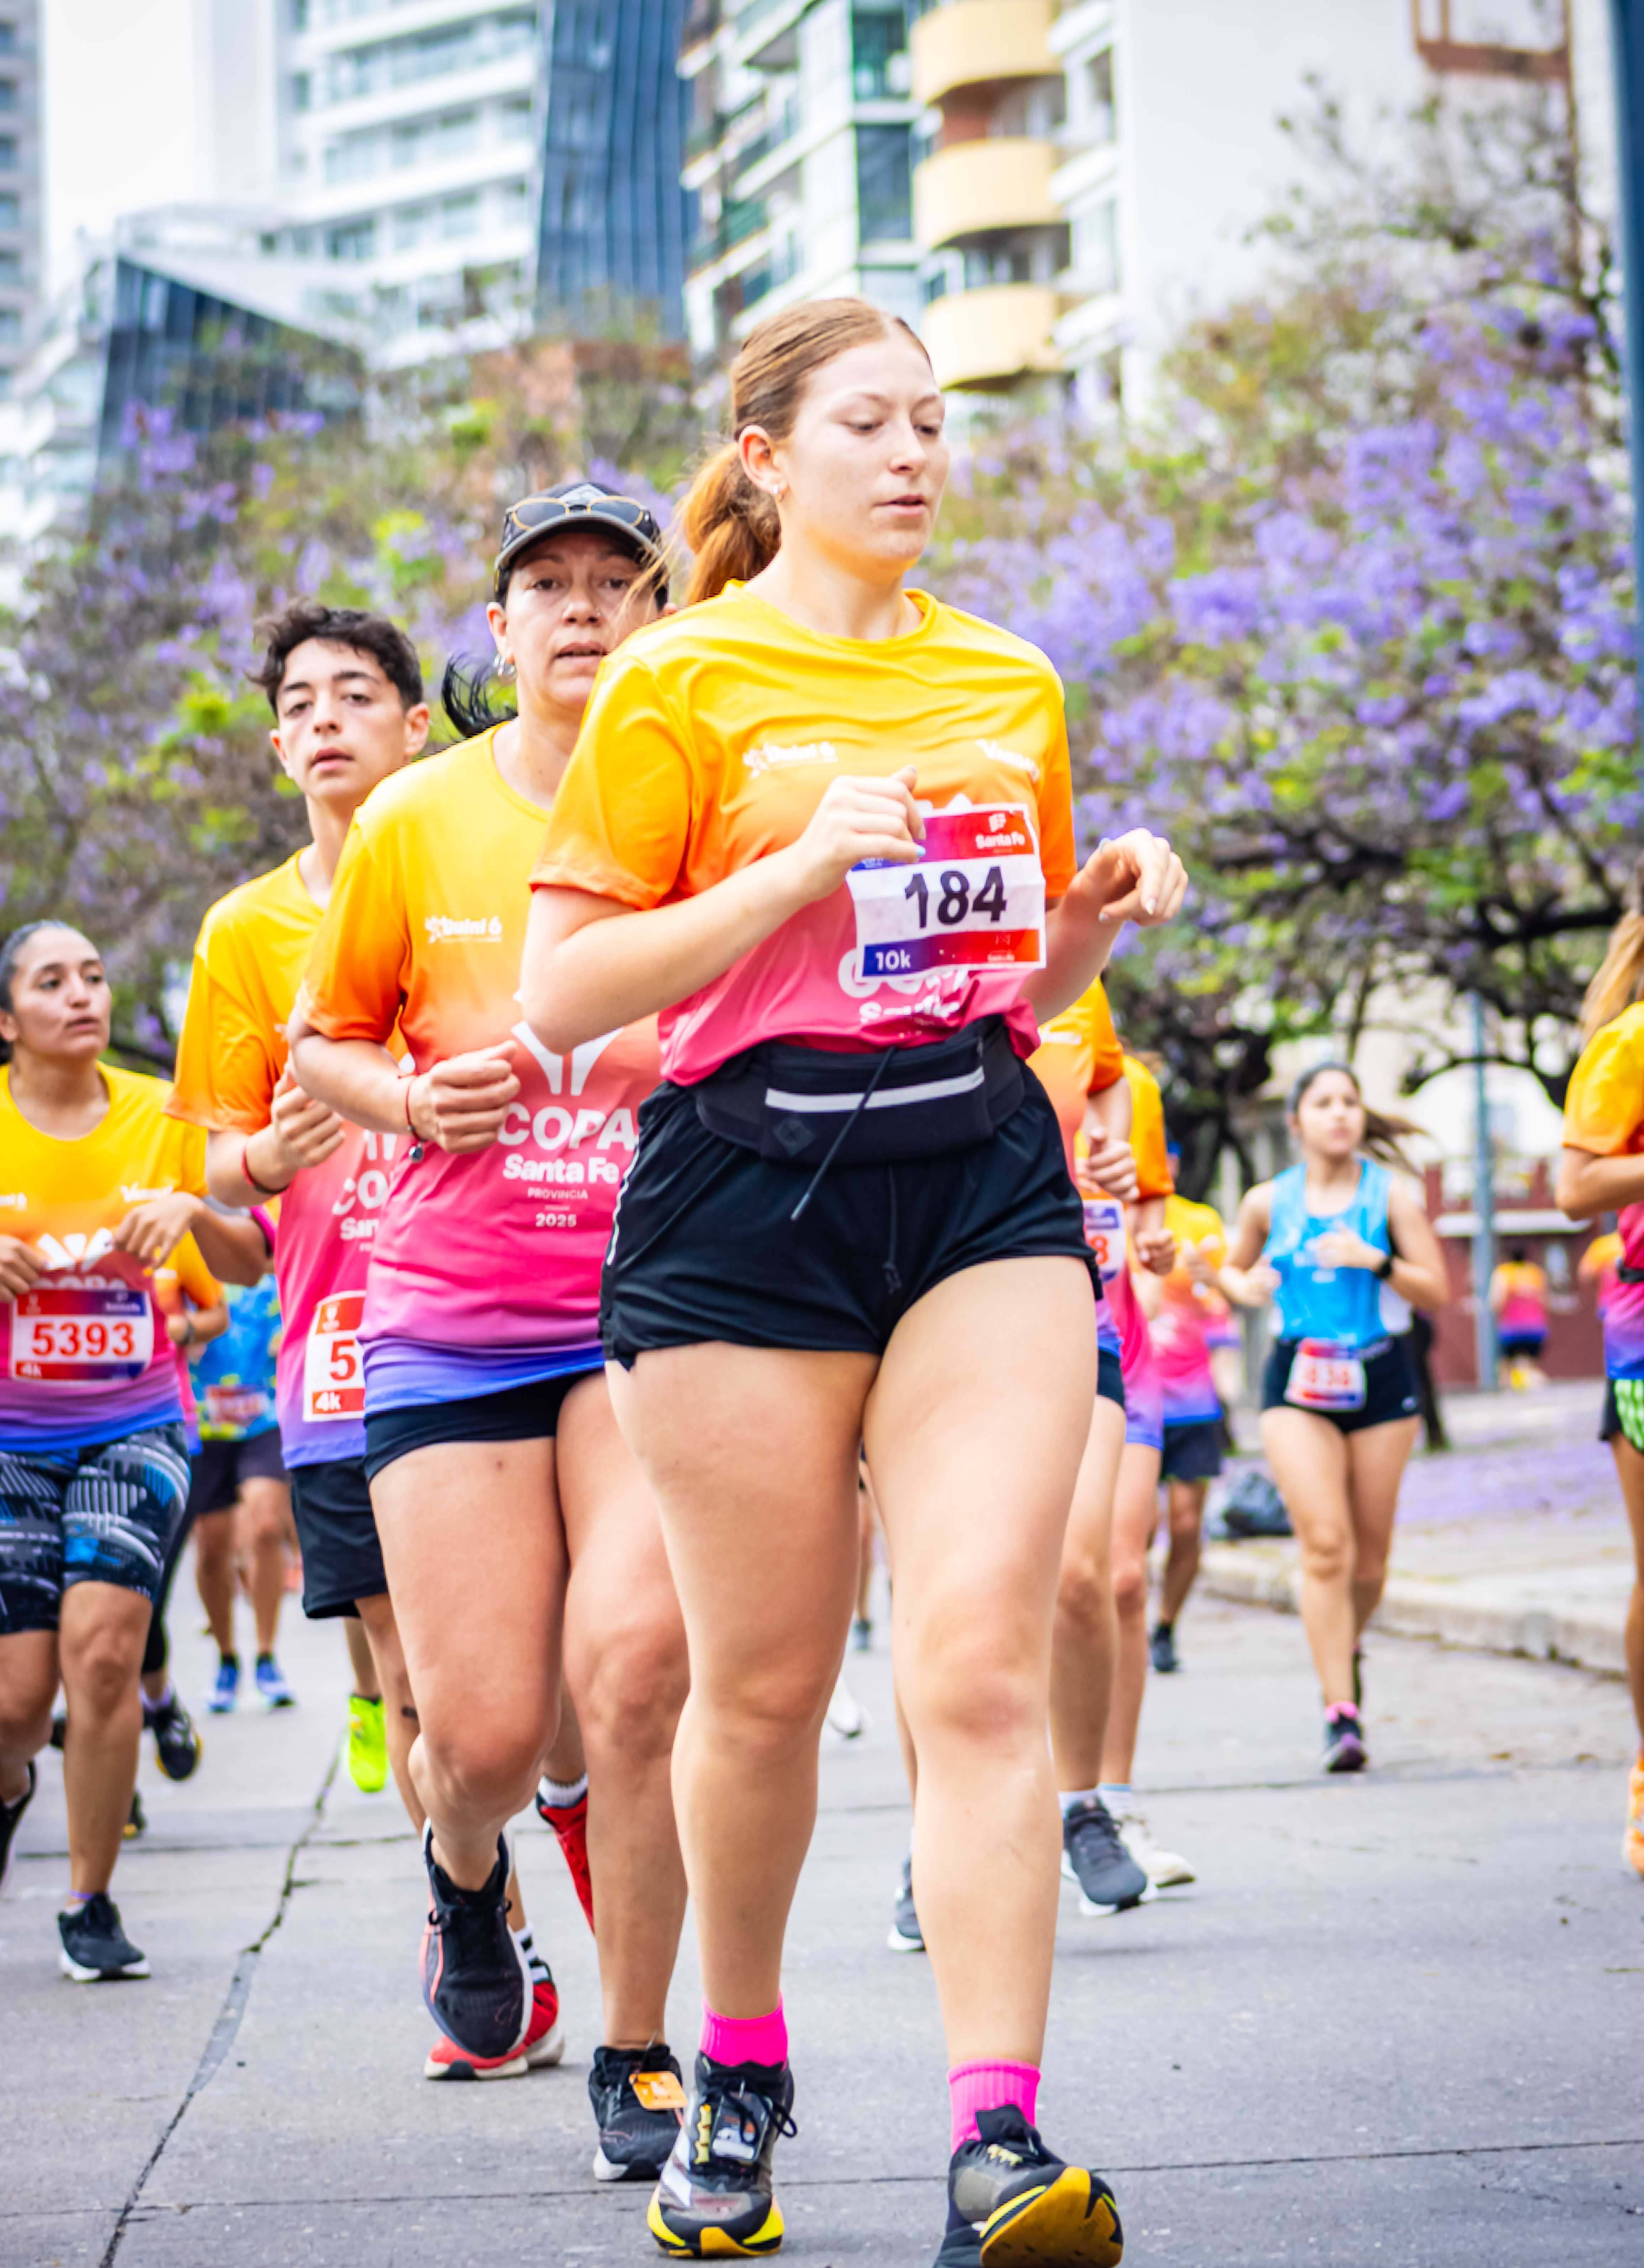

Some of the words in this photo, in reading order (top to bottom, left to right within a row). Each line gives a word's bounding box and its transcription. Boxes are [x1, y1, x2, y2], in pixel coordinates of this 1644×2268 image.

[904, 866, 1007, 929] 184
[489, 915, 502, 936] 6
[875, 949, 912, 971] 10k
[497, 1102, 635, 1150] COPA
[503, 1153, 584, 1183] Santa
[588, 1157, 619, 1184] Fe
[527, 1187, 588, 1200] PROVINCIA
[535, 1212, 577, 1228] 2025
[32, 1321, 135, 1357] 5393
[315, 1391, 341, 1412] 4k
